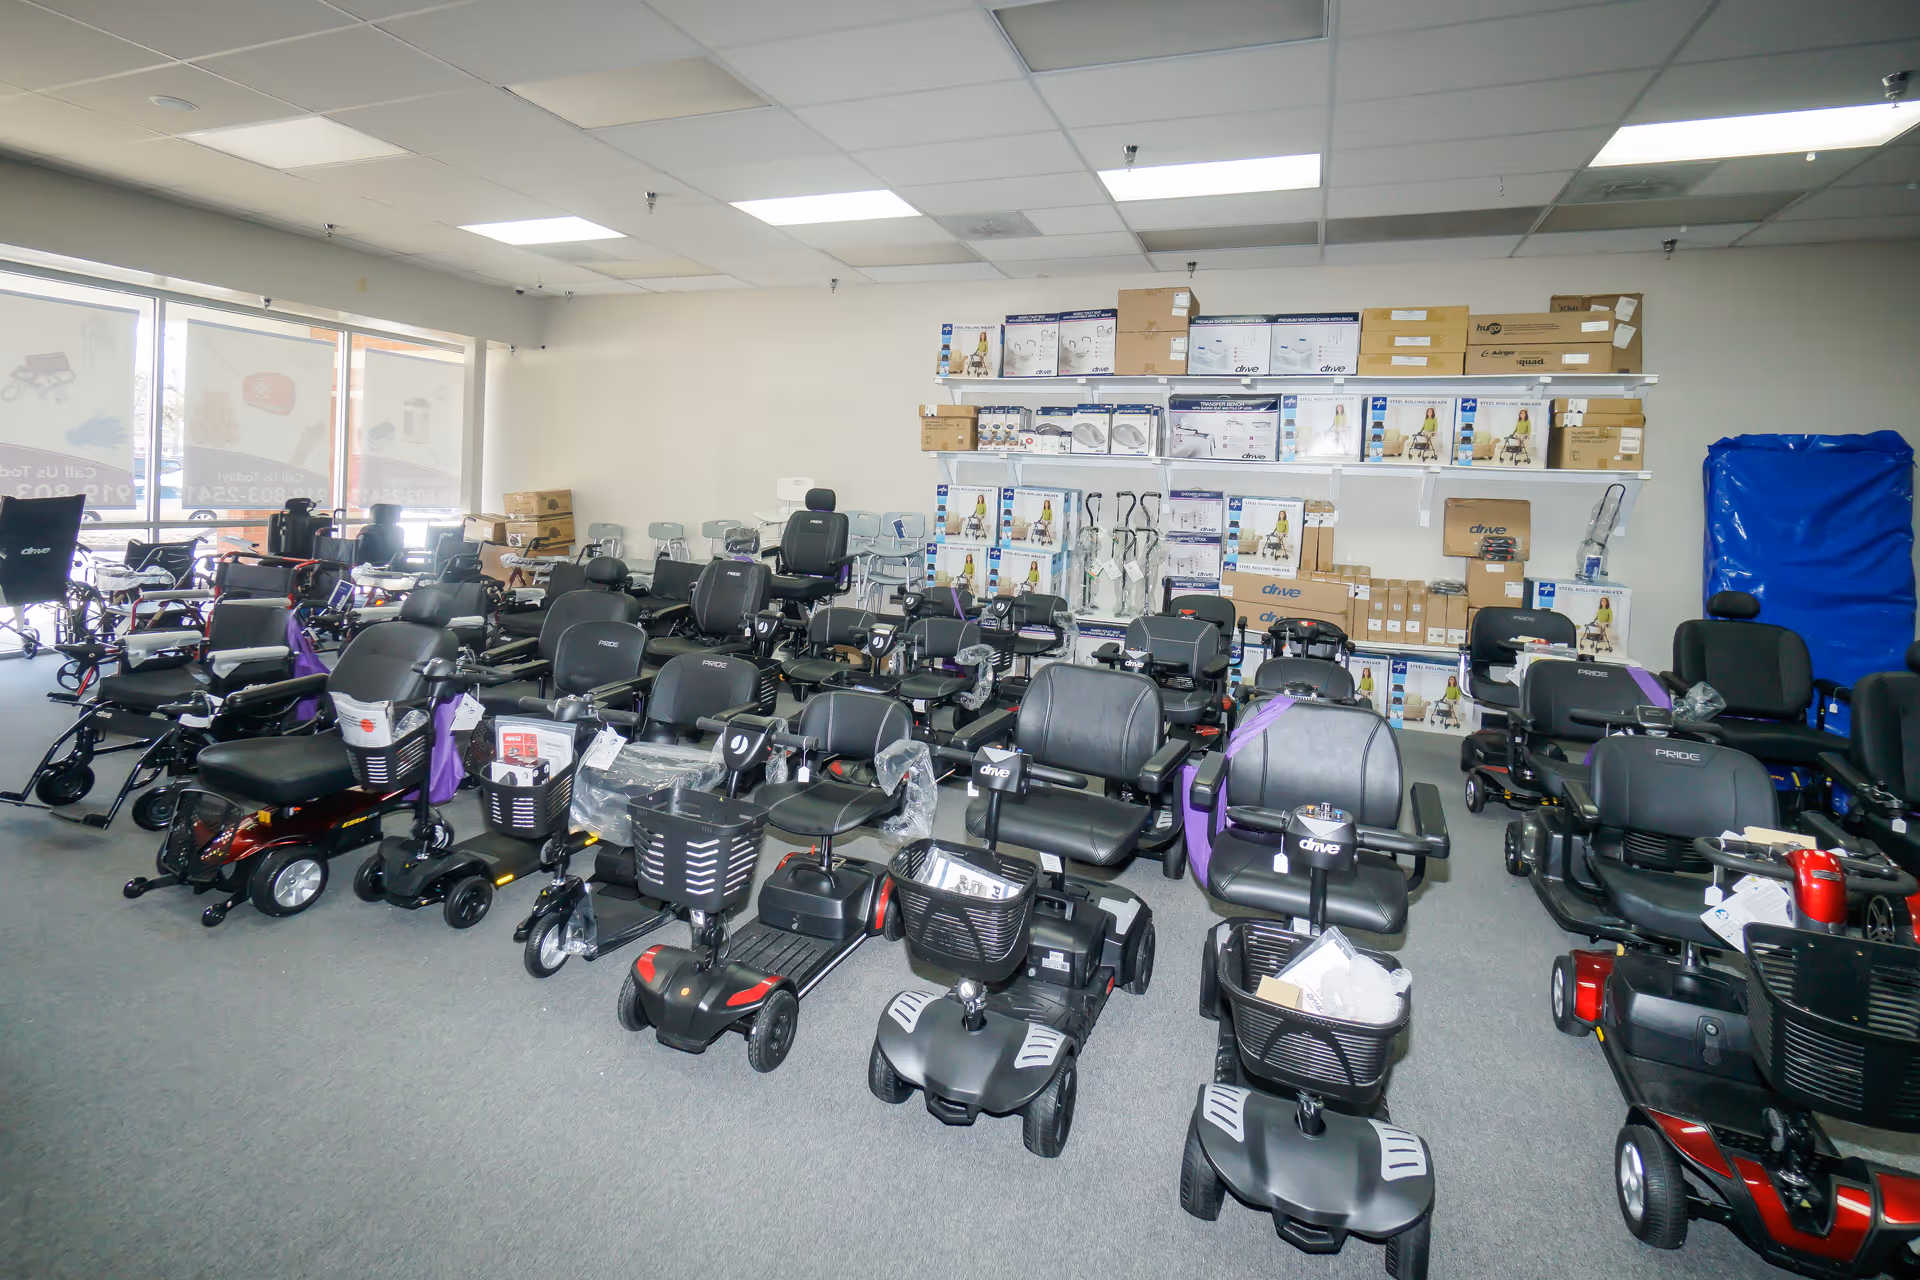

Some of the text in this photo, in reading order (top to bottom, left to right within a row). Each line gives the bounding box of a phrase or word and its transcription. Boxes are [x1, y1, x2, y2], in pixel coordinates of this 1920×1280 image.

[1476, 322, 1502, 335] hugo
[1235, 365, 1260, 373] drive
[1320, 365, 1346, 373] drive
[1242, 452, 1266, 460] drive
[1469, 523, 1507, 535] drive
[20, 546, 51, 555] drive
[1262, 583, 1301, 598] drive
[598, 640, 620, 648] PRIDE
[702, 659, 728, 669] PRIDE
[1125, 659, 1145, 668] drive
[1577, 668, 1609, 678] PRIDE
[1655, 748, 1701, 761] PRIDE
[980, 763, 1010, 778] drive
[1299, 837, 1341, 855] drive
